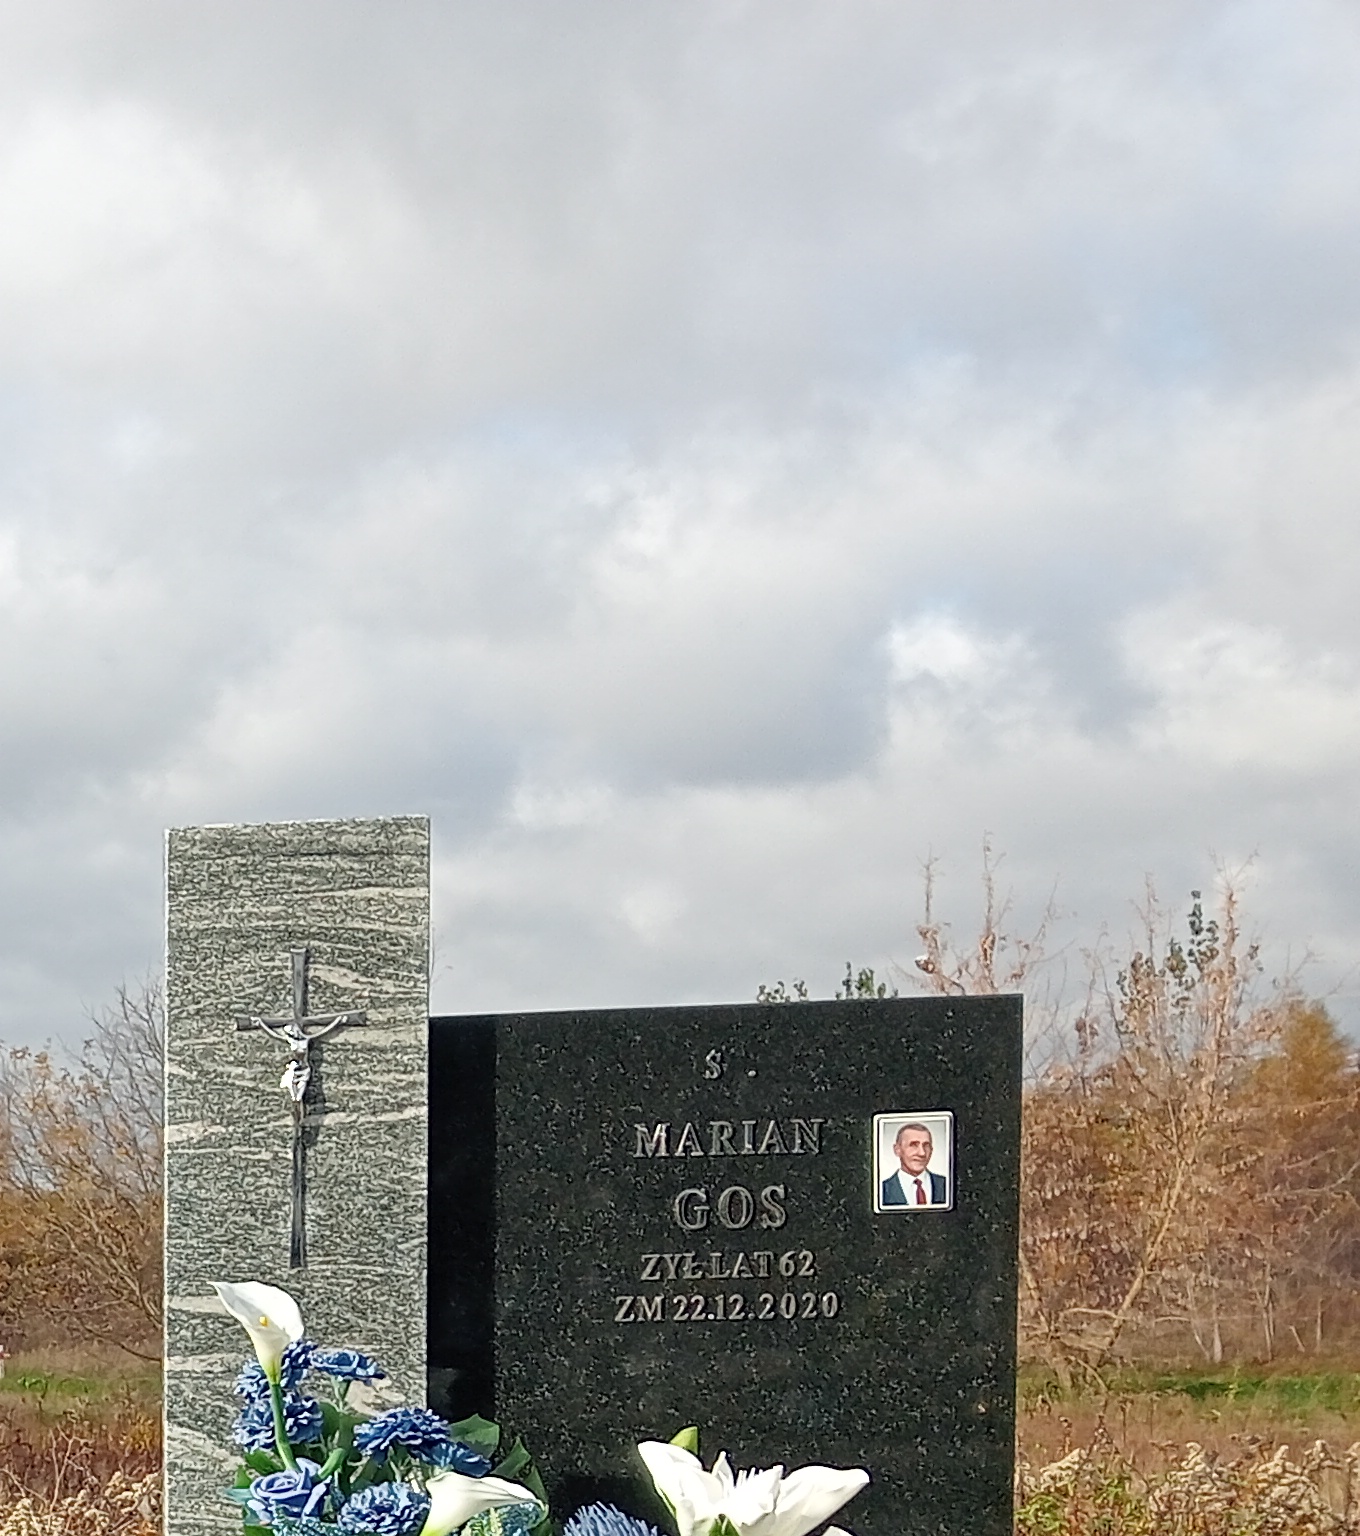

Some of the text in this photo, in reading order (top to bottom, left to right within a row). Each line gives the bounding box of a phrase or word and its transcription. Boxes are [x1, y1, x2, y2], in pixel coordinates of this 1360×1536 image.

[634, 1118, 825, 1158] MARIAN
[674, 1184, 788, 1230] GOS
[708, 1251, 774, 1279] LAT
[779, 1250, 816, 1278] 62
[614, 1291, 840, 1322] ZM 22.12.2020
